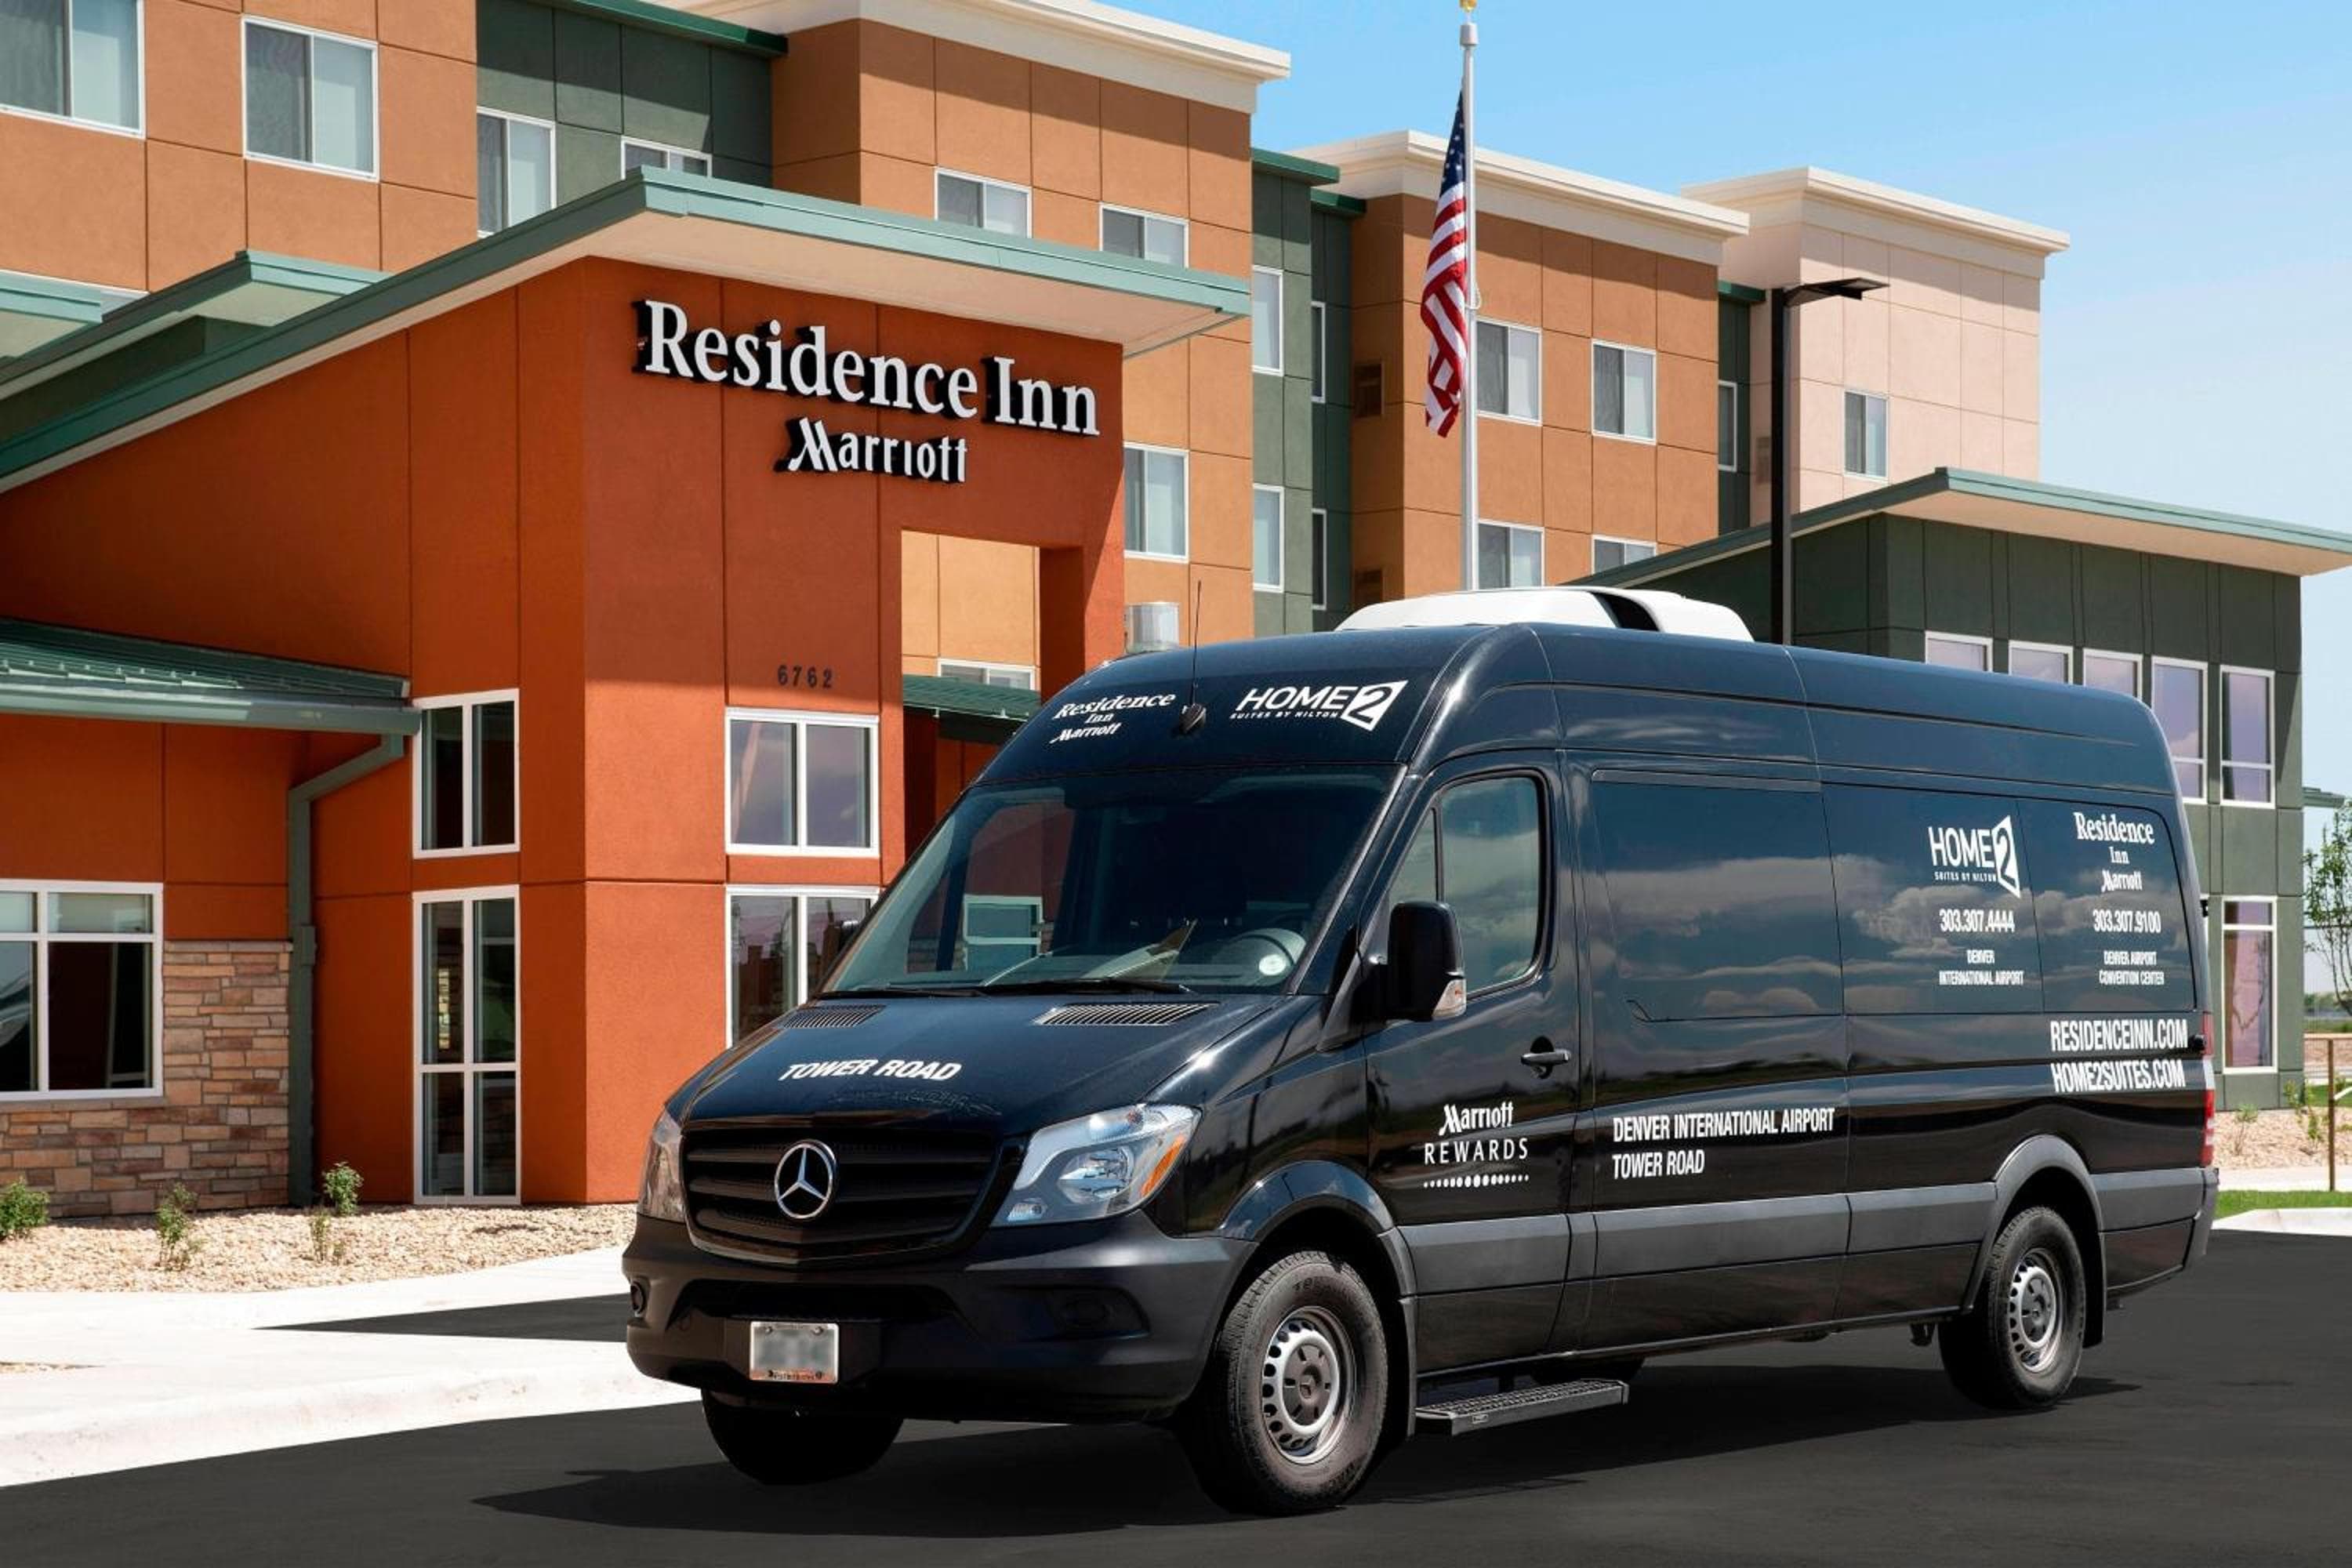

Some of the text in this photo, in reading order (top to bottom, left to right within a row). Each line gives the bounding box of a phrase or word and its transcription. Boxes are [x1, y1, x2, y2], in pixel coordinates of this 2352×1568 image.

[644, 298, 1100, 437] Residence Inn
[786, 416, 968, 483] Marriott
[777, 664, 833, 689] 6762
[1052, 694, 1176, 720] Residence
[1085, 713, 1115, 724] Inn
[1049, 722, 1122, 744] Marriott
[2073, 811, 2155, 844] Residence
[2109, 846, 2130, 864] Inn
[1934, 871, 1959, 880] SUITES
[1973, 873, 1997, 882] HILTON
[2101, 869, 2143, 892] Marriott
[1939, 909, 2016, 933] 303.307.4444
[2092, 909, 2161, 933] 303.307.9100
[1966, 949, 1995, 964] DENVER
[2103, 950, 2157, 965] DENVER AIRPORT
[1939, 970, 2024, 985] INTERNATIONAL AIRPORT
[2099, 969, 2165, 985] CONVENTION CENTER
[2049, 1018, 2189, 1052] RESIDENCEINN.COM
[778, 1059, 963, 1081] TOWER ROAD
[2049, 1059, 2187, 1093] HOME2SUITES.COM
[1438, 1101, 1514, 1136] Marriott
[1613, 1108, 1835, 1142] DENVER INTERNATIONAL AIRPORT
[1424, 1138, 1528, 1166] REWARDS
[1612, 1149, 1706, 1180] TOWER ROAD
